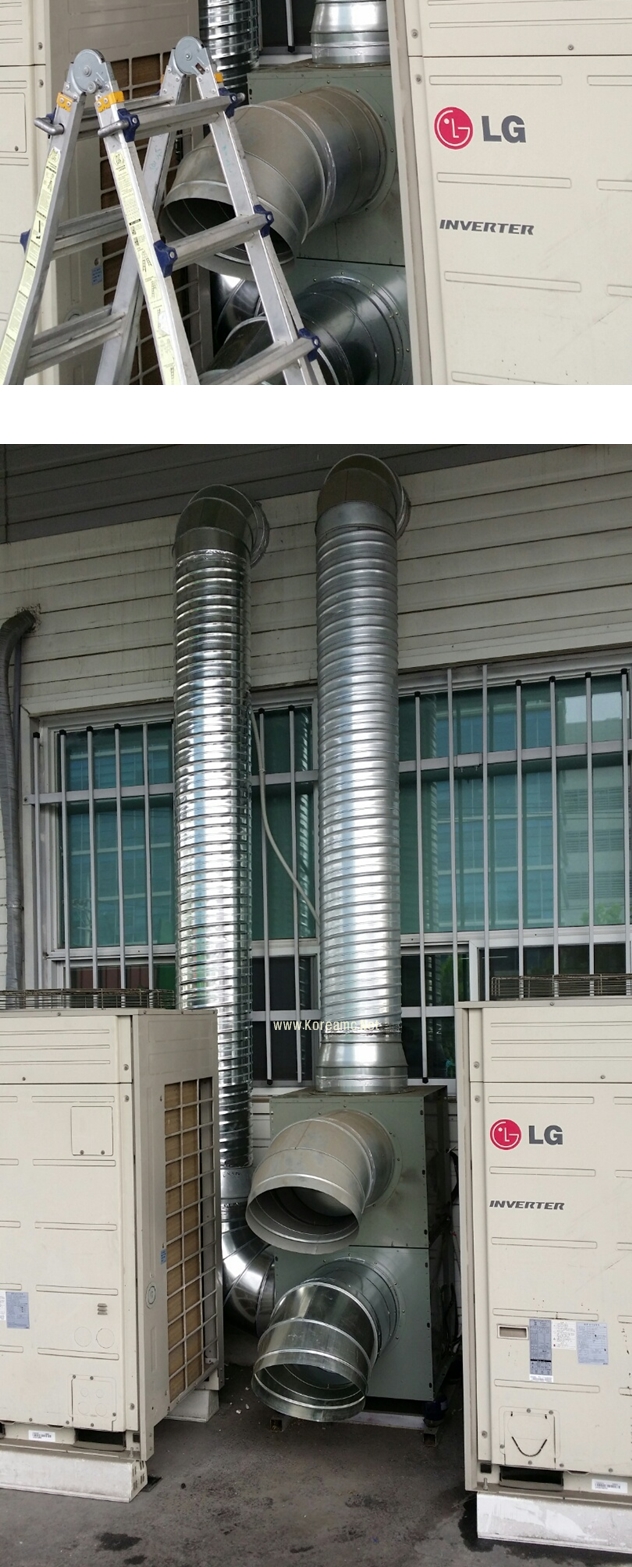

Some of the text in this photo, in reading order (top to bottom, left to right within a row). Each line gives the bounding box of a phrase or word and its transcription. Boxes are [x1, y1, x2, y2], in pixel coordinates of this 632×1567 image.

[481, 115, 527, 143] LG
[439, 219, 535, 235] INVERTER
[528, 1124, 564, 1146] LG
[489, 1200, 565, 1211] INVERTER
